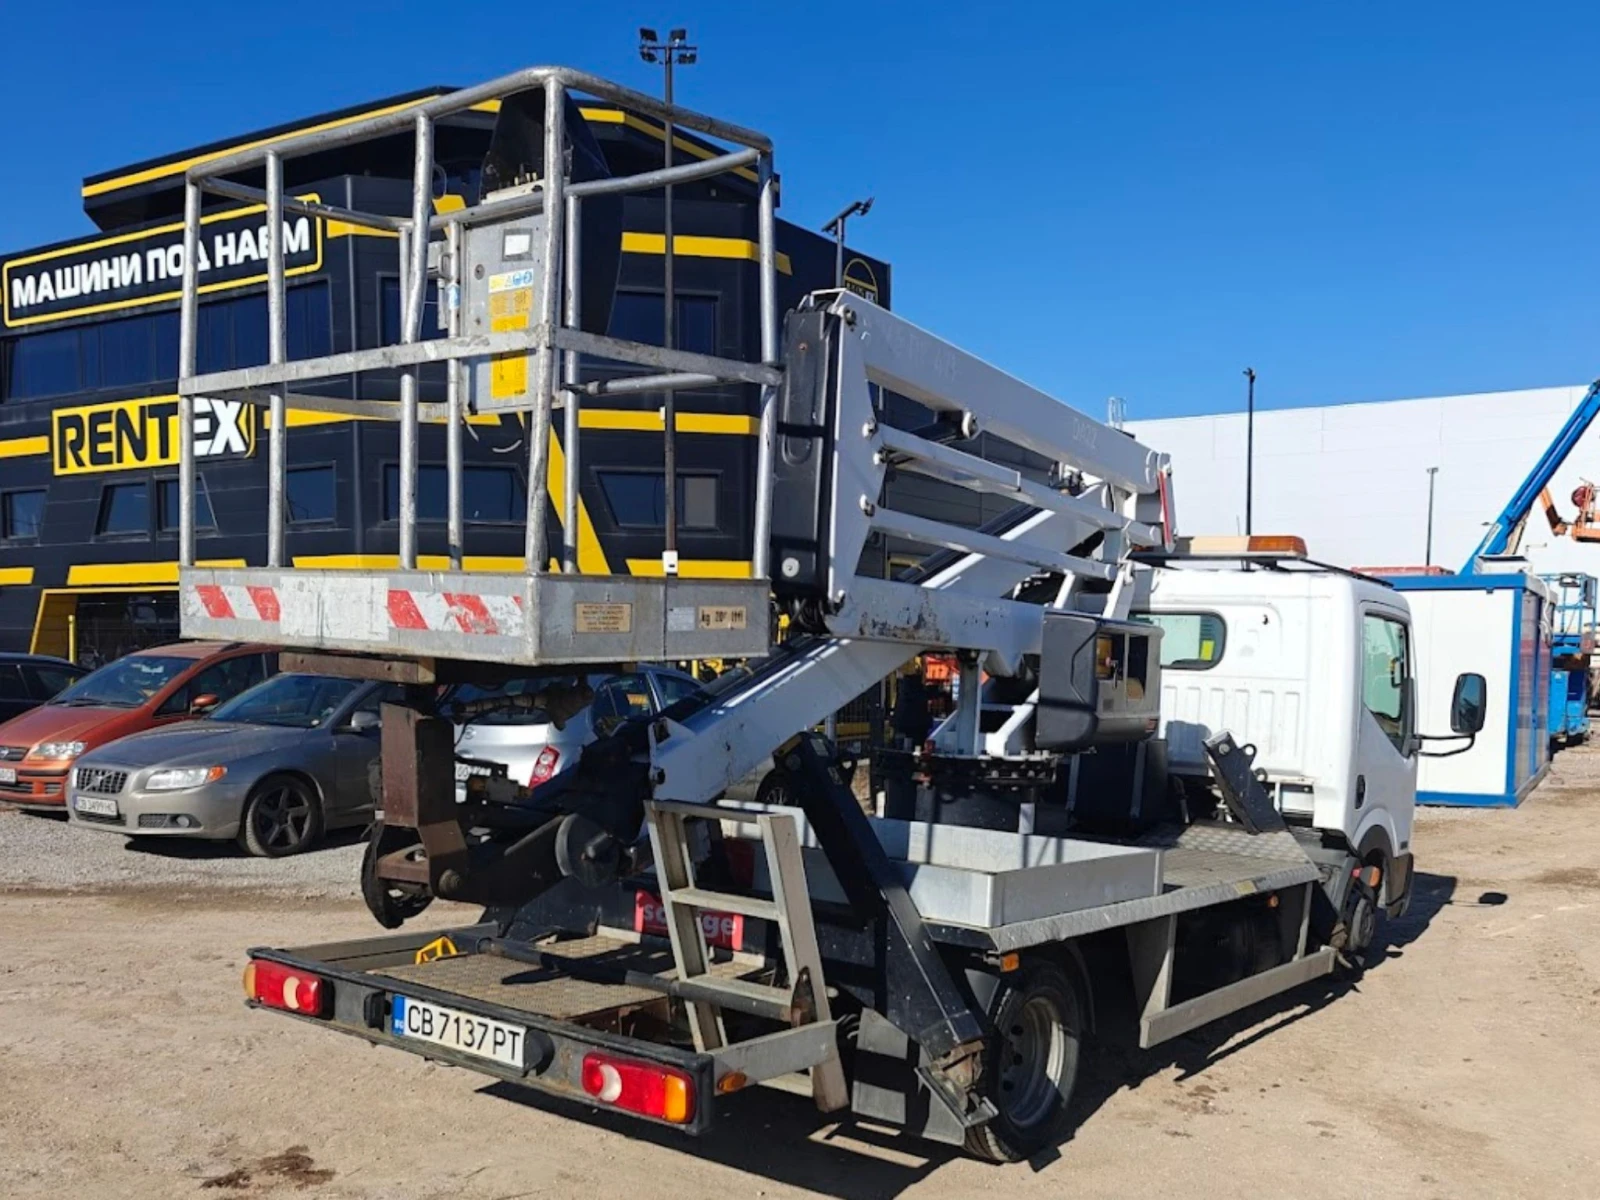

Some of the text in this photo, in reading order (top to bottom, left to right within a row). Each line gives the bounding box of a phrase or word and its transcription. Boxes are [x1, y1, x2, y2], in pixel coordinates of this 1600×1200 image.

[12, 252, 142, 309] МАШИНИ
[214, 216, 310, 268] НАЕМ
[58, 397, 246, 469] RENTEX
[645, 904, 734, 938] soge
[408, 1005, 521, 1060] CB 7137 PT
